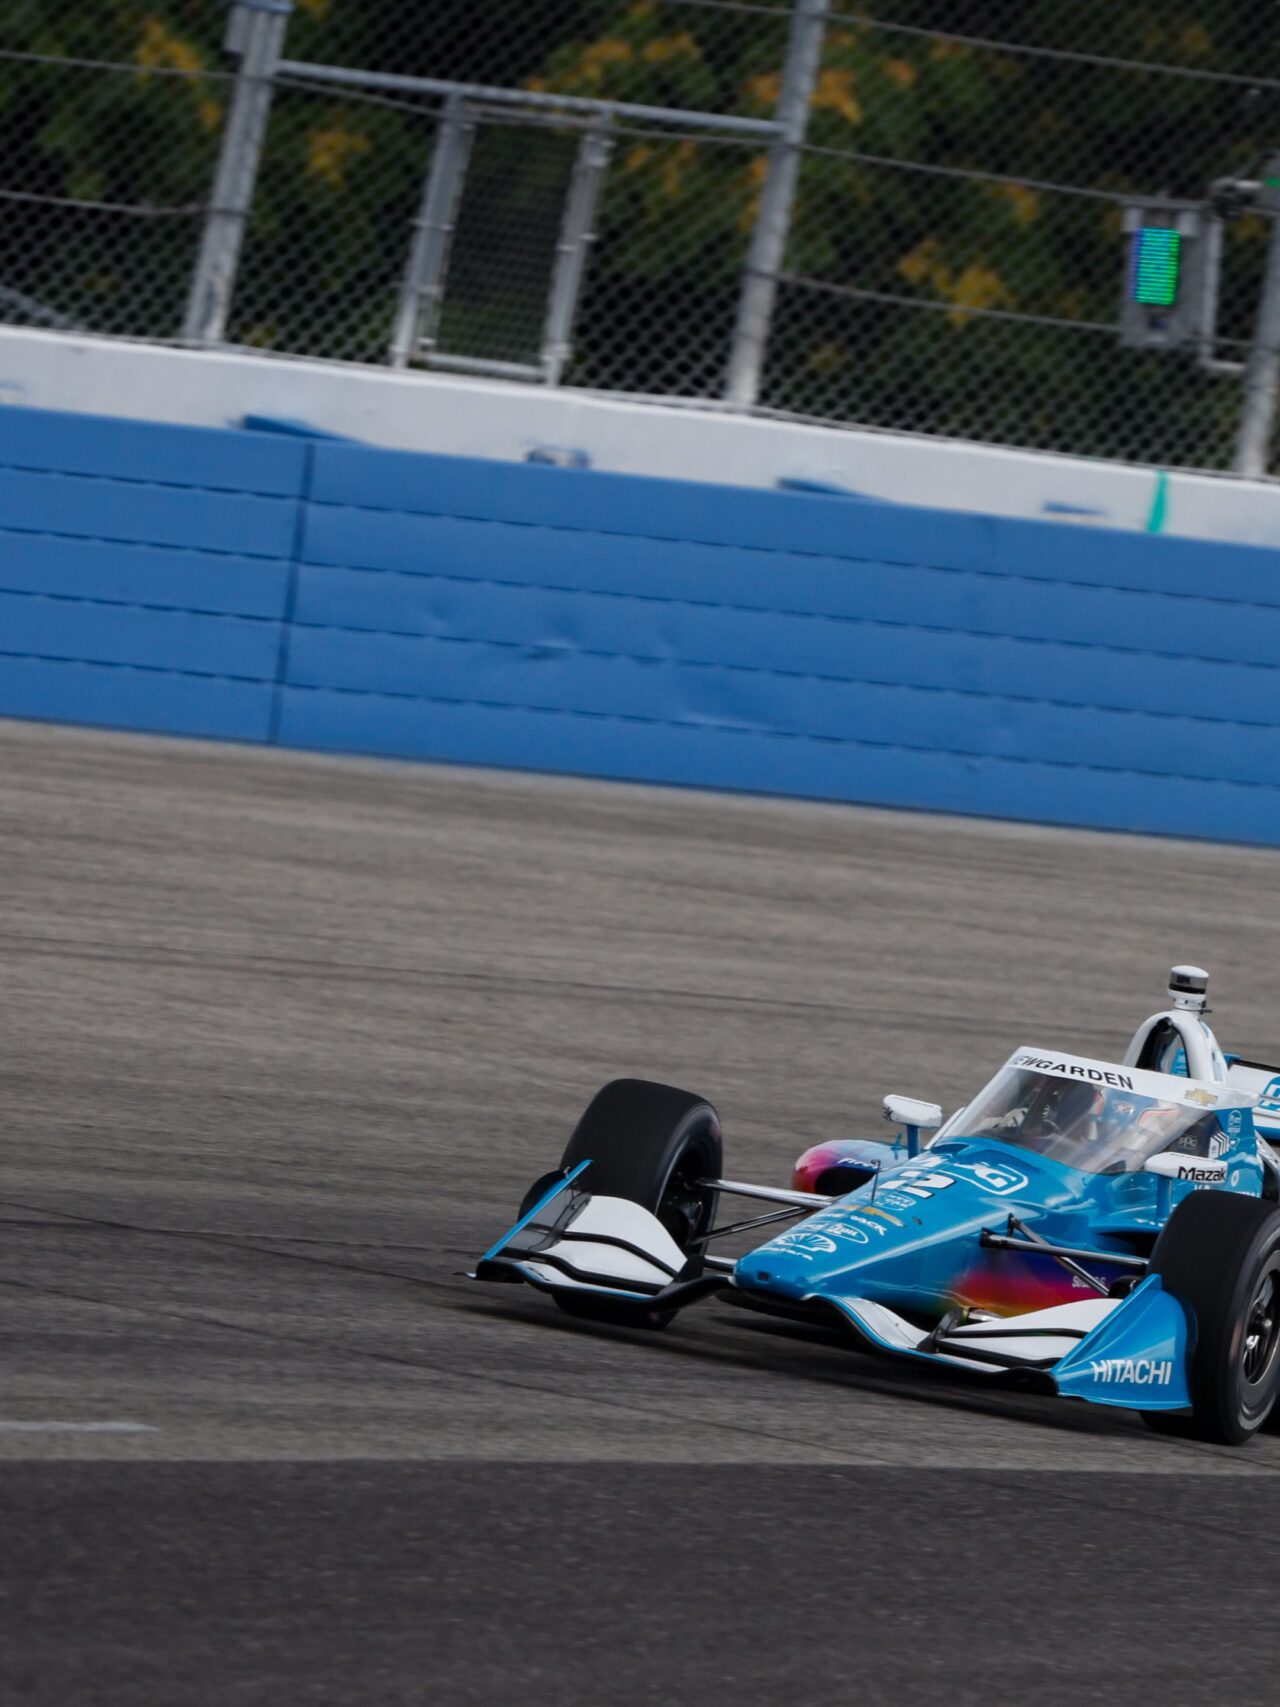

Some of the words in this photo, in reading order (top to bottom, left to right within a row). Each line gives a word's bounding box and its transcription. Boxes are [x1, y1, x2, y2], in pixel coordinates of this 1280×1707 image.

[1008, 1055, 1134, 1090] EWGARDEN
[1178, 1166, 1226, 1182] Mazak
[1091, 1359, 1172, 1385] HITACHI
